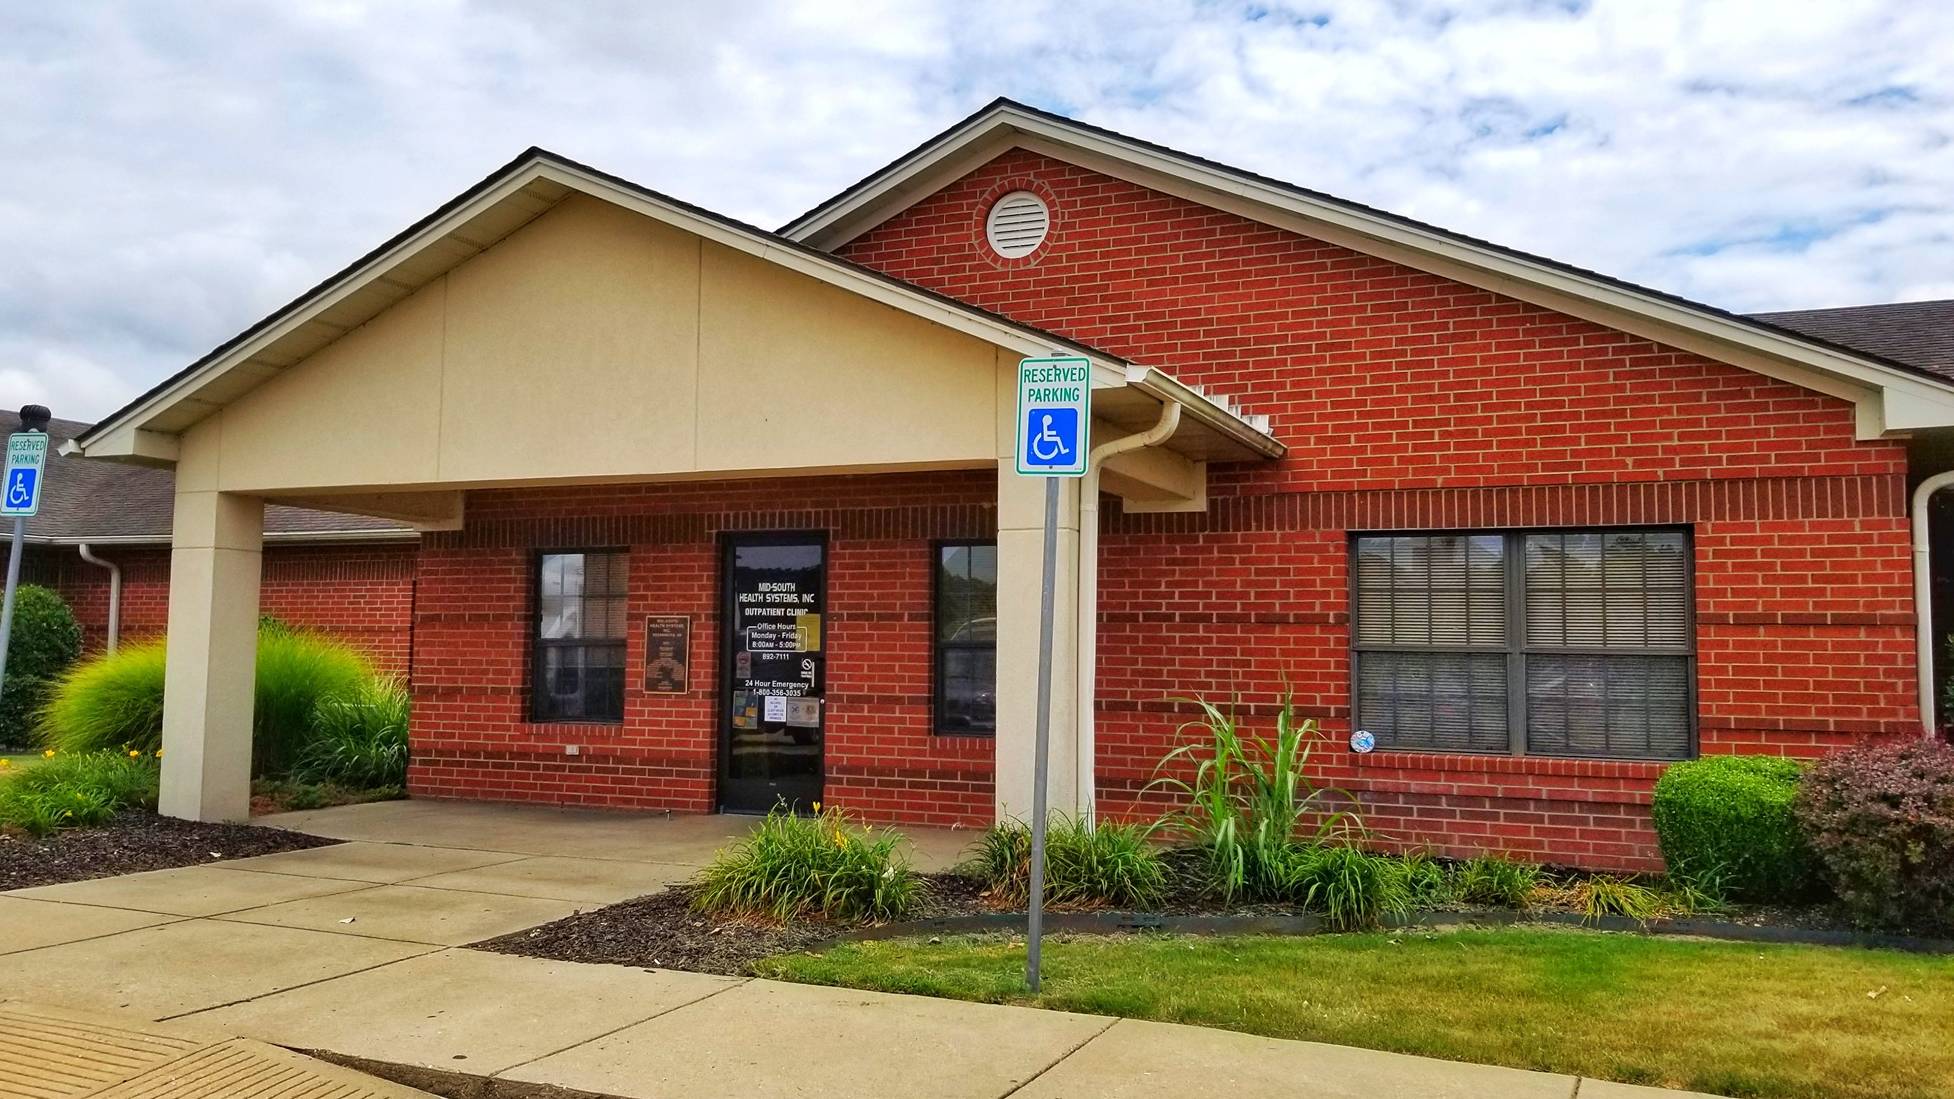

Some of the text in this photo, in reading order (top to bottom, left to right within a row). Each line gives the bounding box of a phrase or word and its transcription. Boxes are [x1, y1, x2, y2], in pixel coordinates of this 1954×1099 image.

[1024, 367, 1086, 383] RESERVED
[1028, 387, 1080, 402] PARKING
[11, 440, 45, 451] RESERVED
[11, 454, 40, 464] PARKING
[758, 582, 796, 592] MID-SOUTH
[739, 593, 815, 604] HEALTH SYSTEMS, INC
[745, 607, 785, 616] OUTPATIENT
[757, 622, 796, 630] Office Hours
[751, 632, 777, 640] Monday
[781, 632, 802, 640] Friday
[771, 680, 809, 690] Emergency
